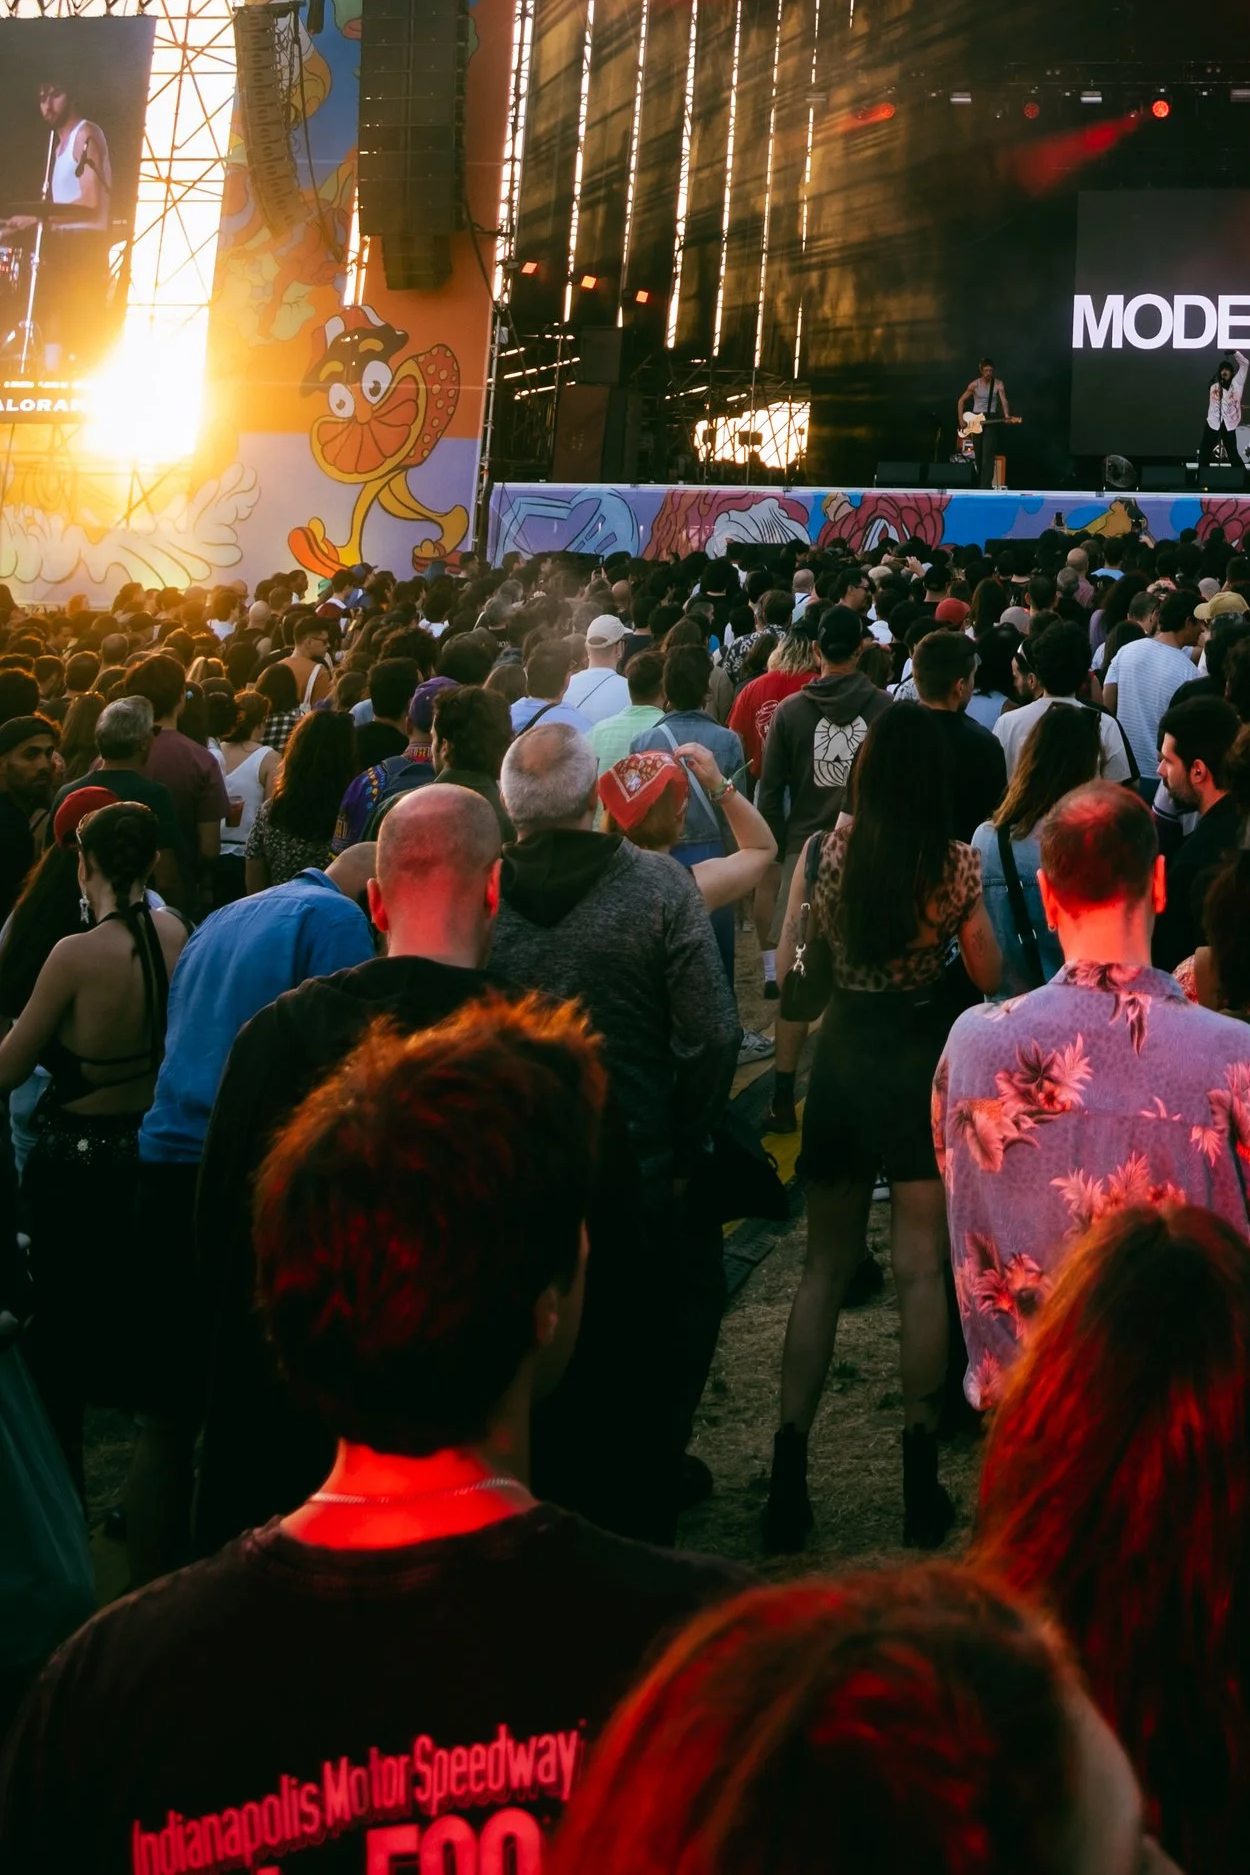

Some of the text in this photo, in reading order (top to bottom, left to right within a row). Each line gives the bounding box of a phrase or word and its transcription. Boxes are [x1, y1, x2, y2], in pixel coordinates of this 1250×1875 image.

[132, 1723, 579, 1875] Indianapolis Motor Speedway
